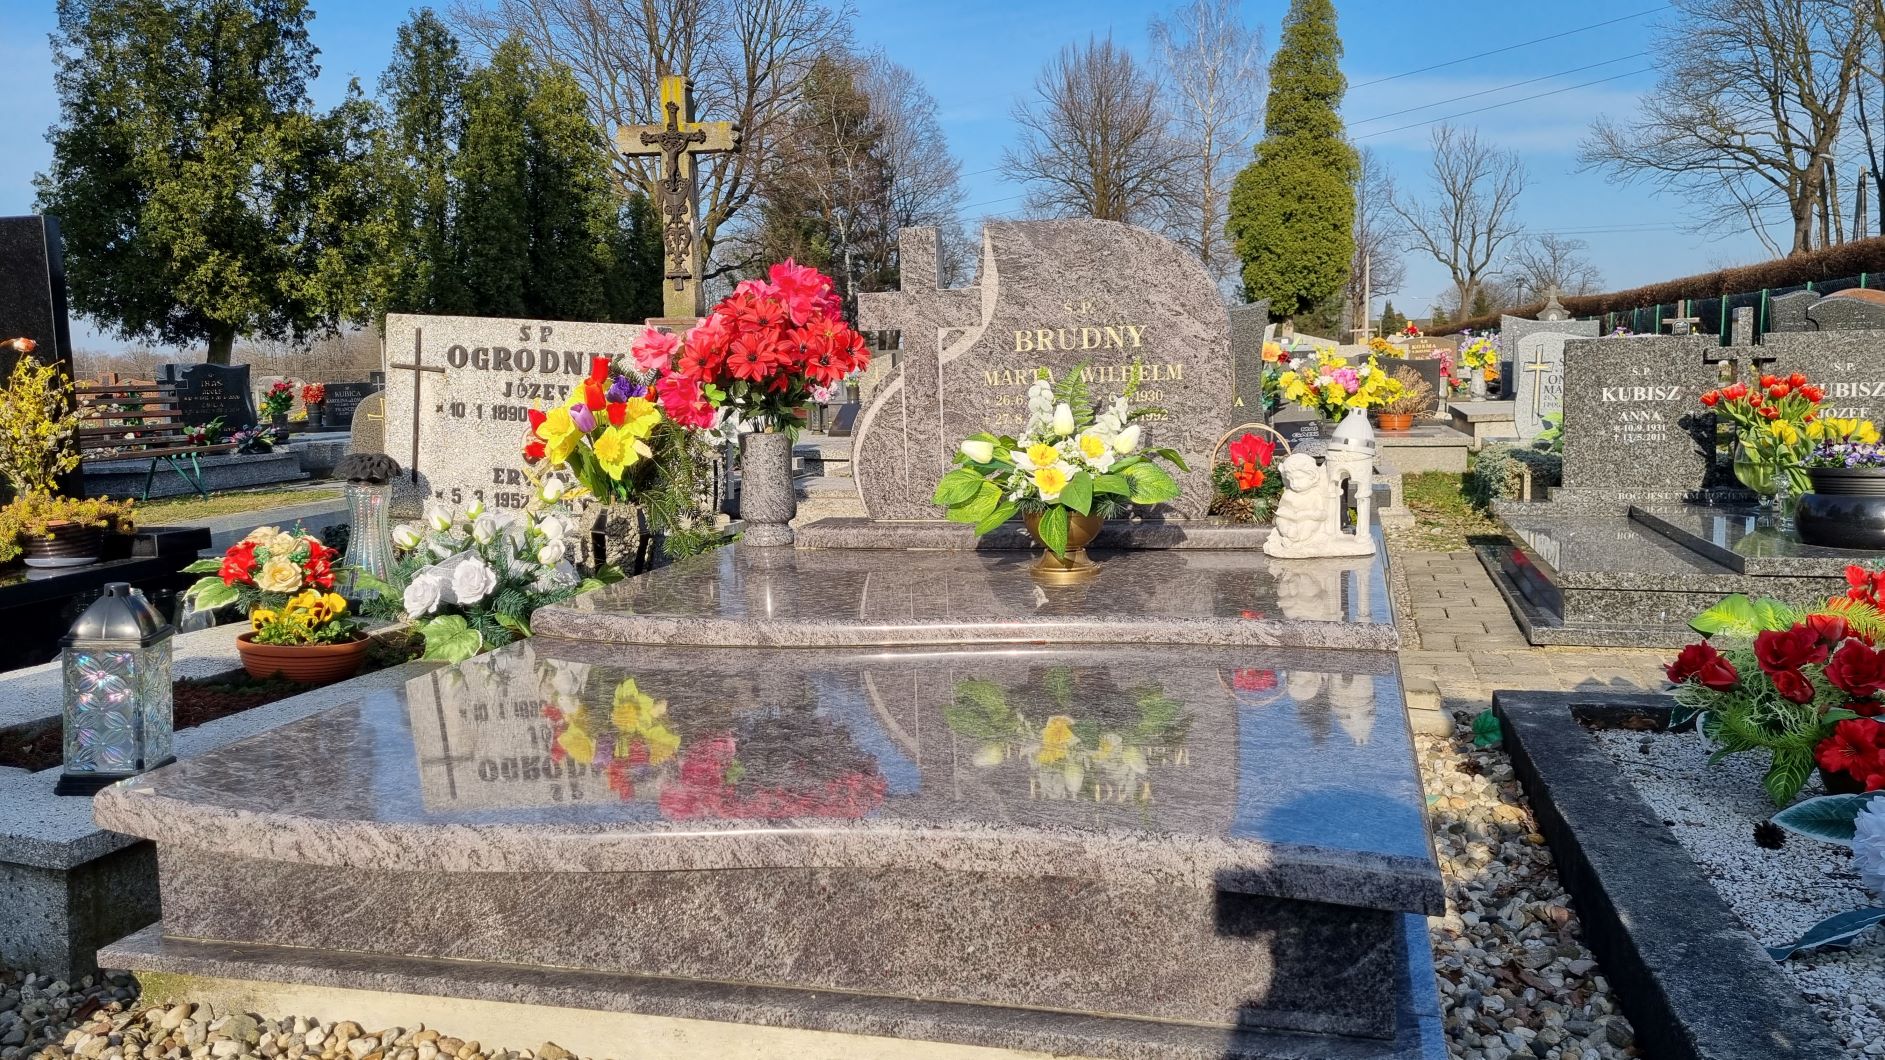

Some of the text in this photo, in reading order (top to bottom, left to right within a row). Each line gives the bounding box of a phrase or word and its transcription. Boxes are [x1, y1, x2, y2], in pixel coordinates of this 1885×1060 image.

[539, 325, 553, 342] P
[1013, 325, 1148, 352] BRUDNY
[1080, 363, 1185, 383] WILHELM
[502, 376, 570, 401] JÓZEF
[1601, 386, 1681, 402] KUBISZ
[1813, 382, 1885, 399] UBISZ
[449, 402, 528, 422] 10 1 1890
[1618, 411, 1662, 422] ANNA
[492, 468, 571, 488] ERN
[451, 488, 462, 504] 5
